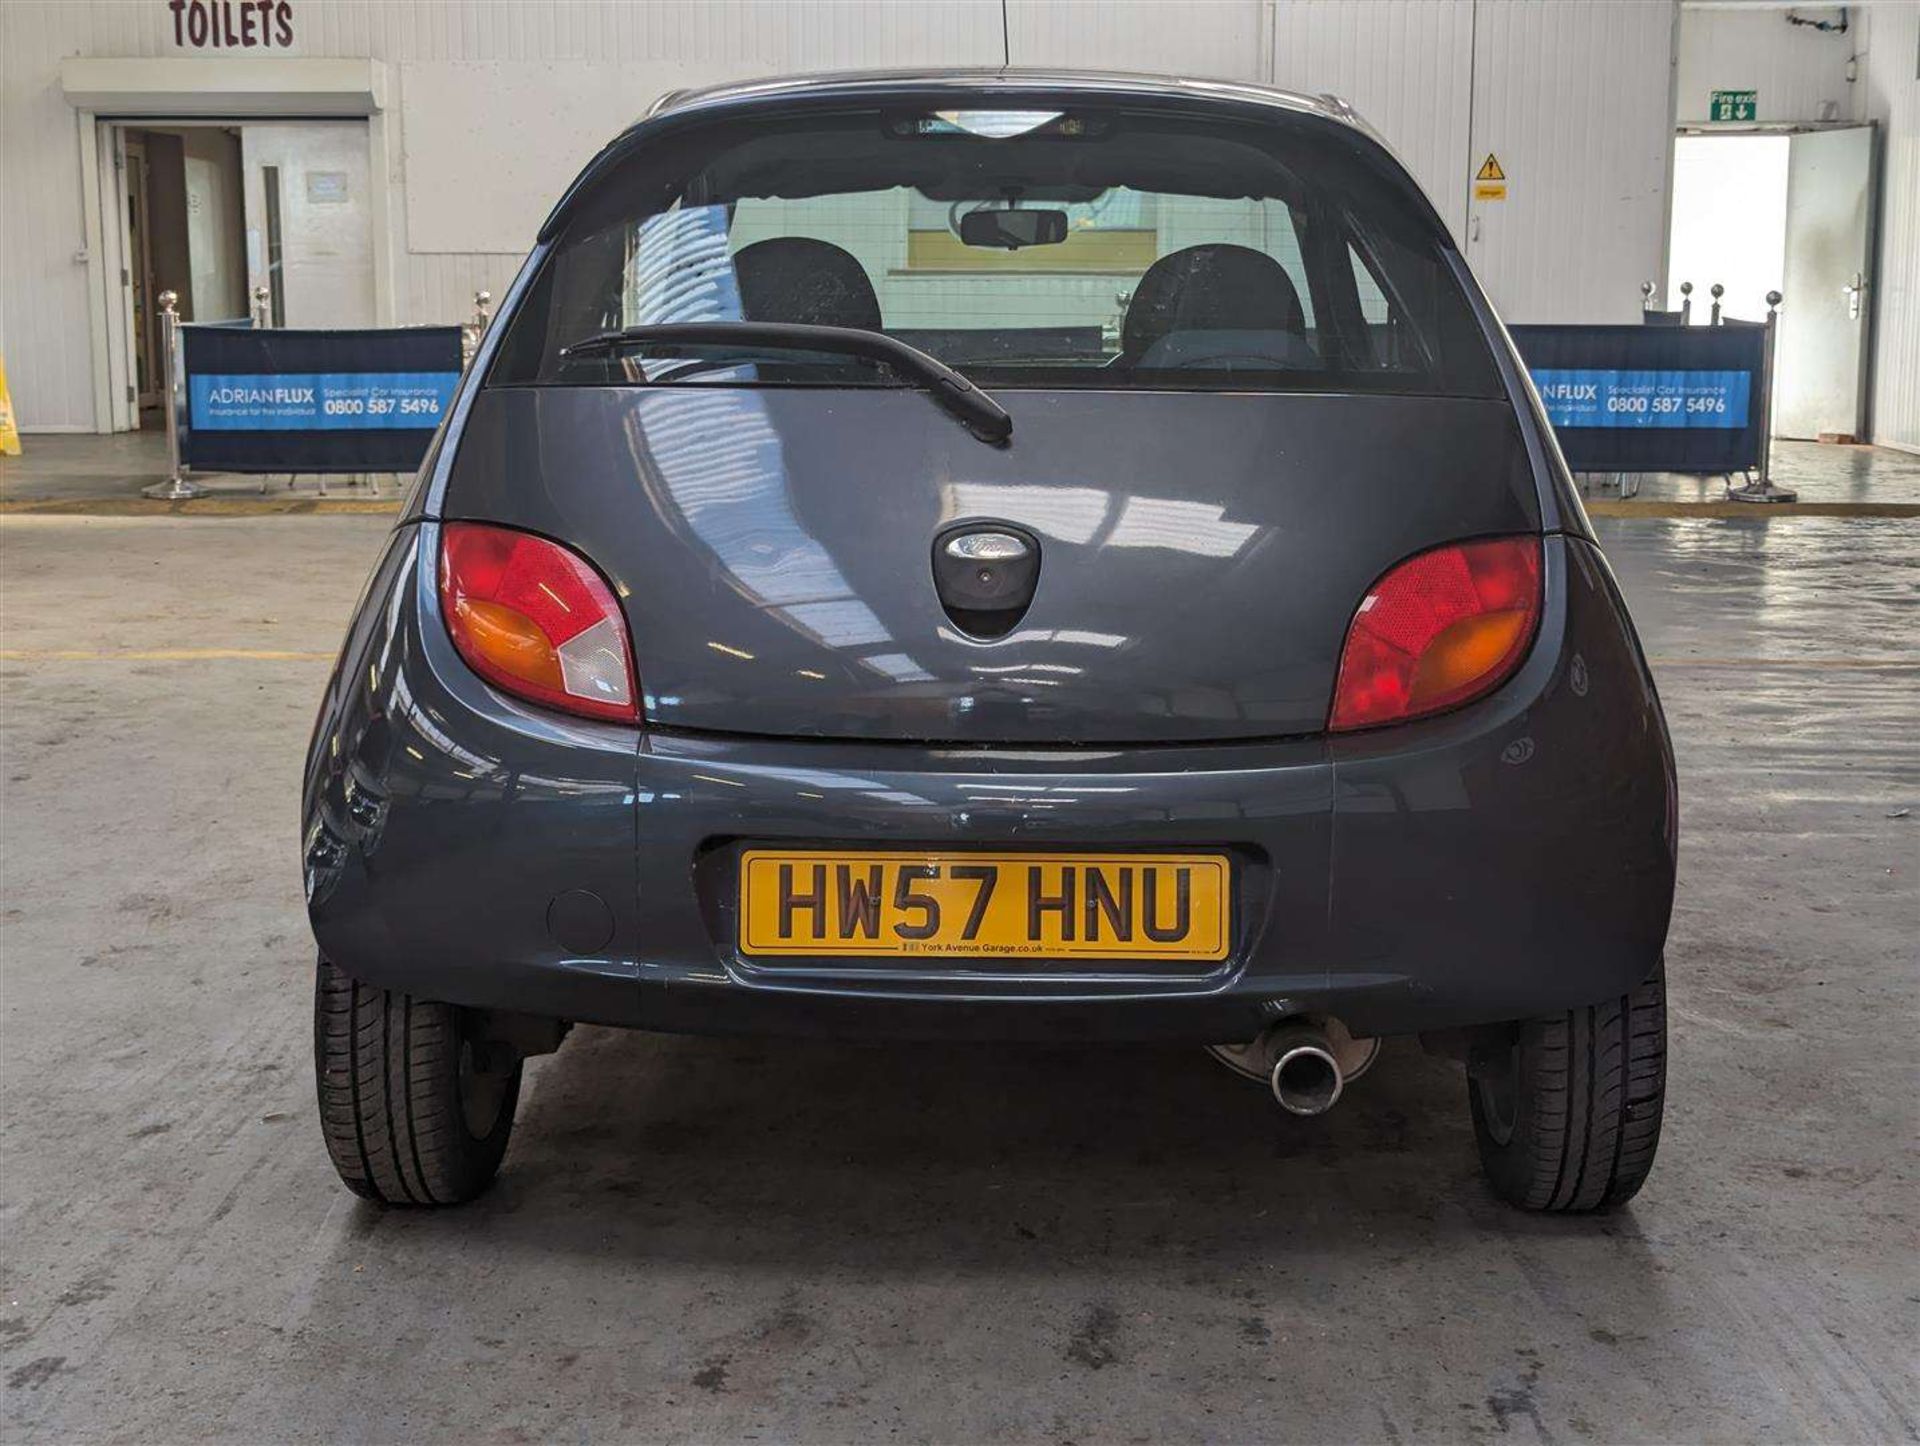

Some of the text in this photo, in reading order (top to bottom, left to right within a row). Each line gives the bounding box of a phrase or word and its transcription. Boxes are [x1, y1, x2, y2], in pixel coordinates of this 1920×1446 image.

[169, 0, 294, 48] TOILETS
[1711, 92, 1757, 104] Fire exit
[324, 399, 439, 415] 0800 587 5496
[1607, 397, 1725, 412] 0800 587 5496
[778, 864, 1190, 942] HW57 HNU
[922, 943, 942, 952] York
[945, 943, 979, 952] Avenue
[982, 943, 1042, 954] Garage.co.uk
